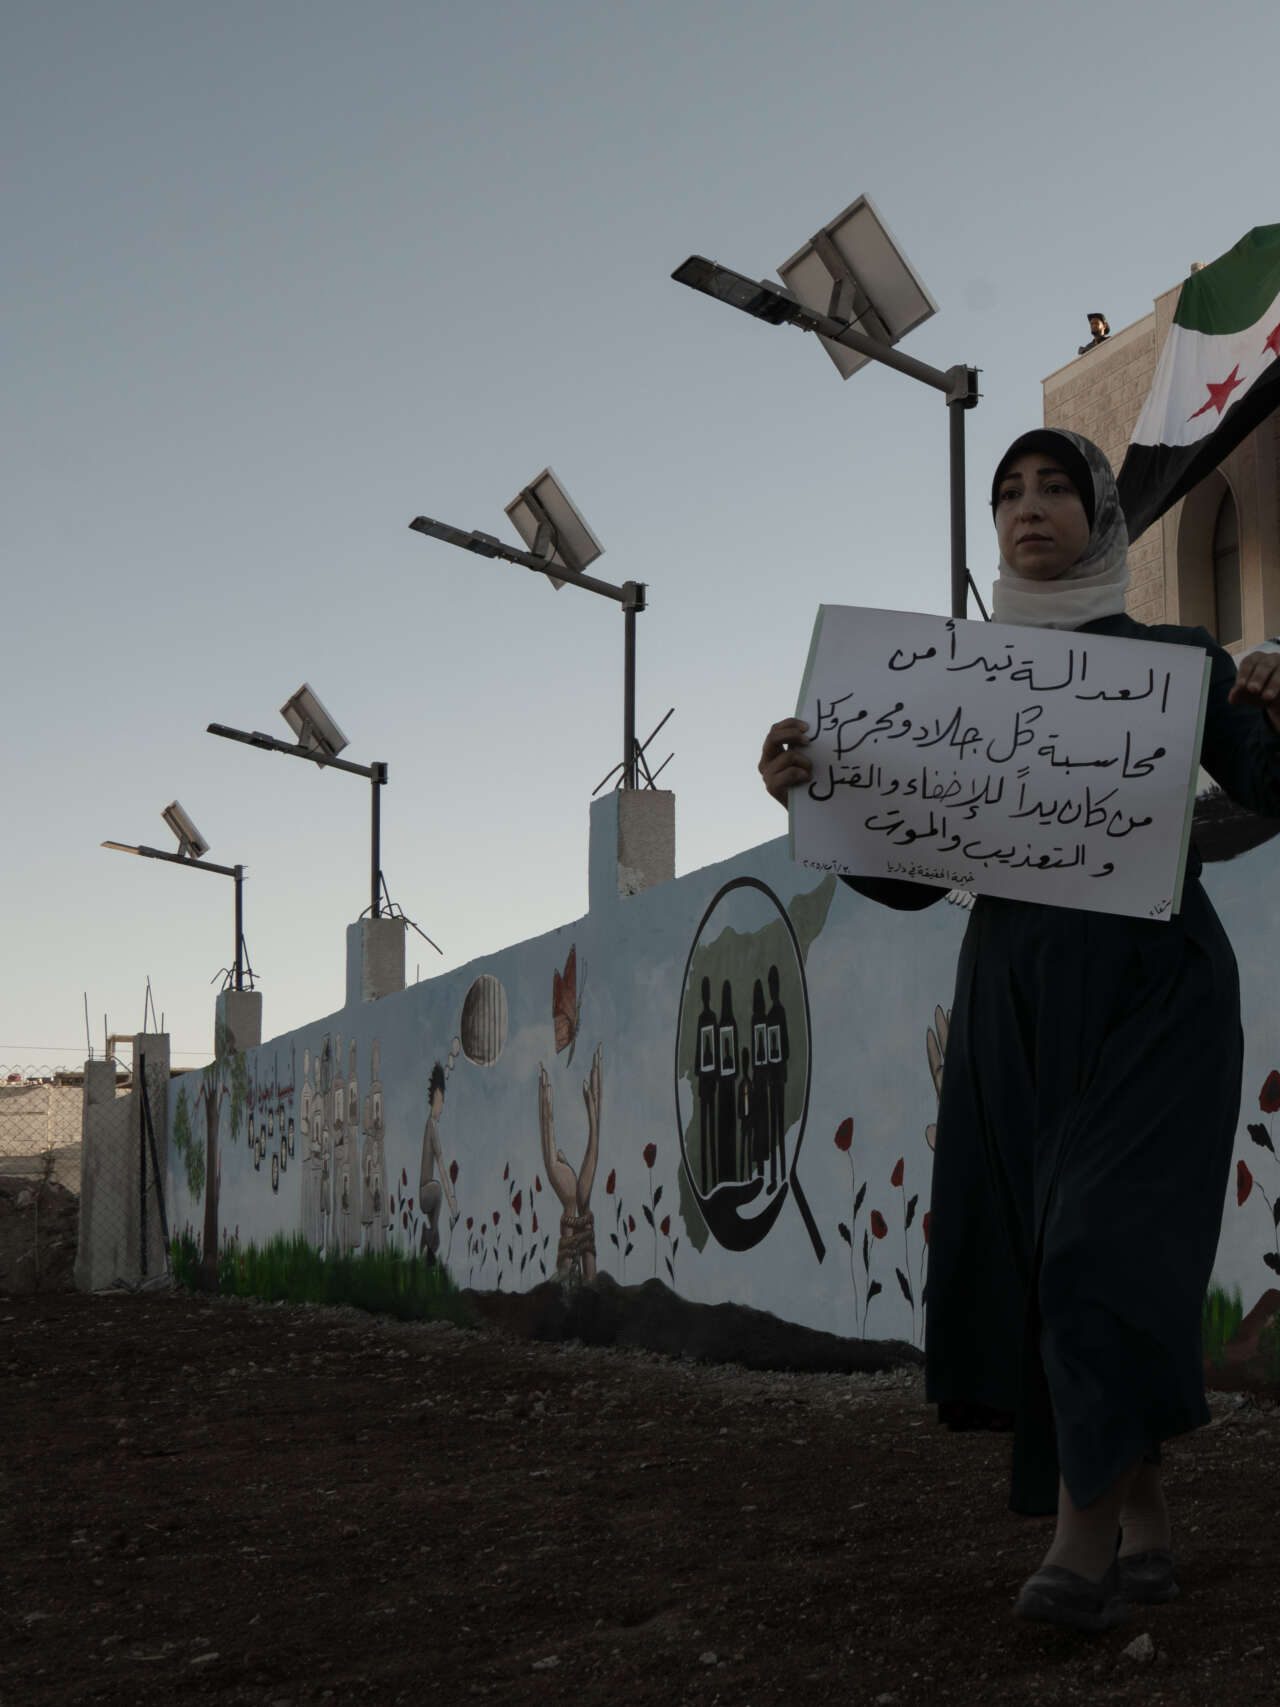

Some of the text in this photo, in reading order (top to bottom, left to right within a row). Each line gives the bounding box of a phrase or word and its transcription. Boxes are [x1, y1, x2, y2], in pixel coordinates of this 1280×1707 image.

[888, 645, 937, 671] من
[945, 619, 1014, 682] تبدأ
[808, 693, 1167, 779] محاسبة كل جلاد ومجرم وكل
[1057, 785, 1119, 828] كان
[1106, 801, 1154, 837] من
[864, 808, 961, 853] والموت
